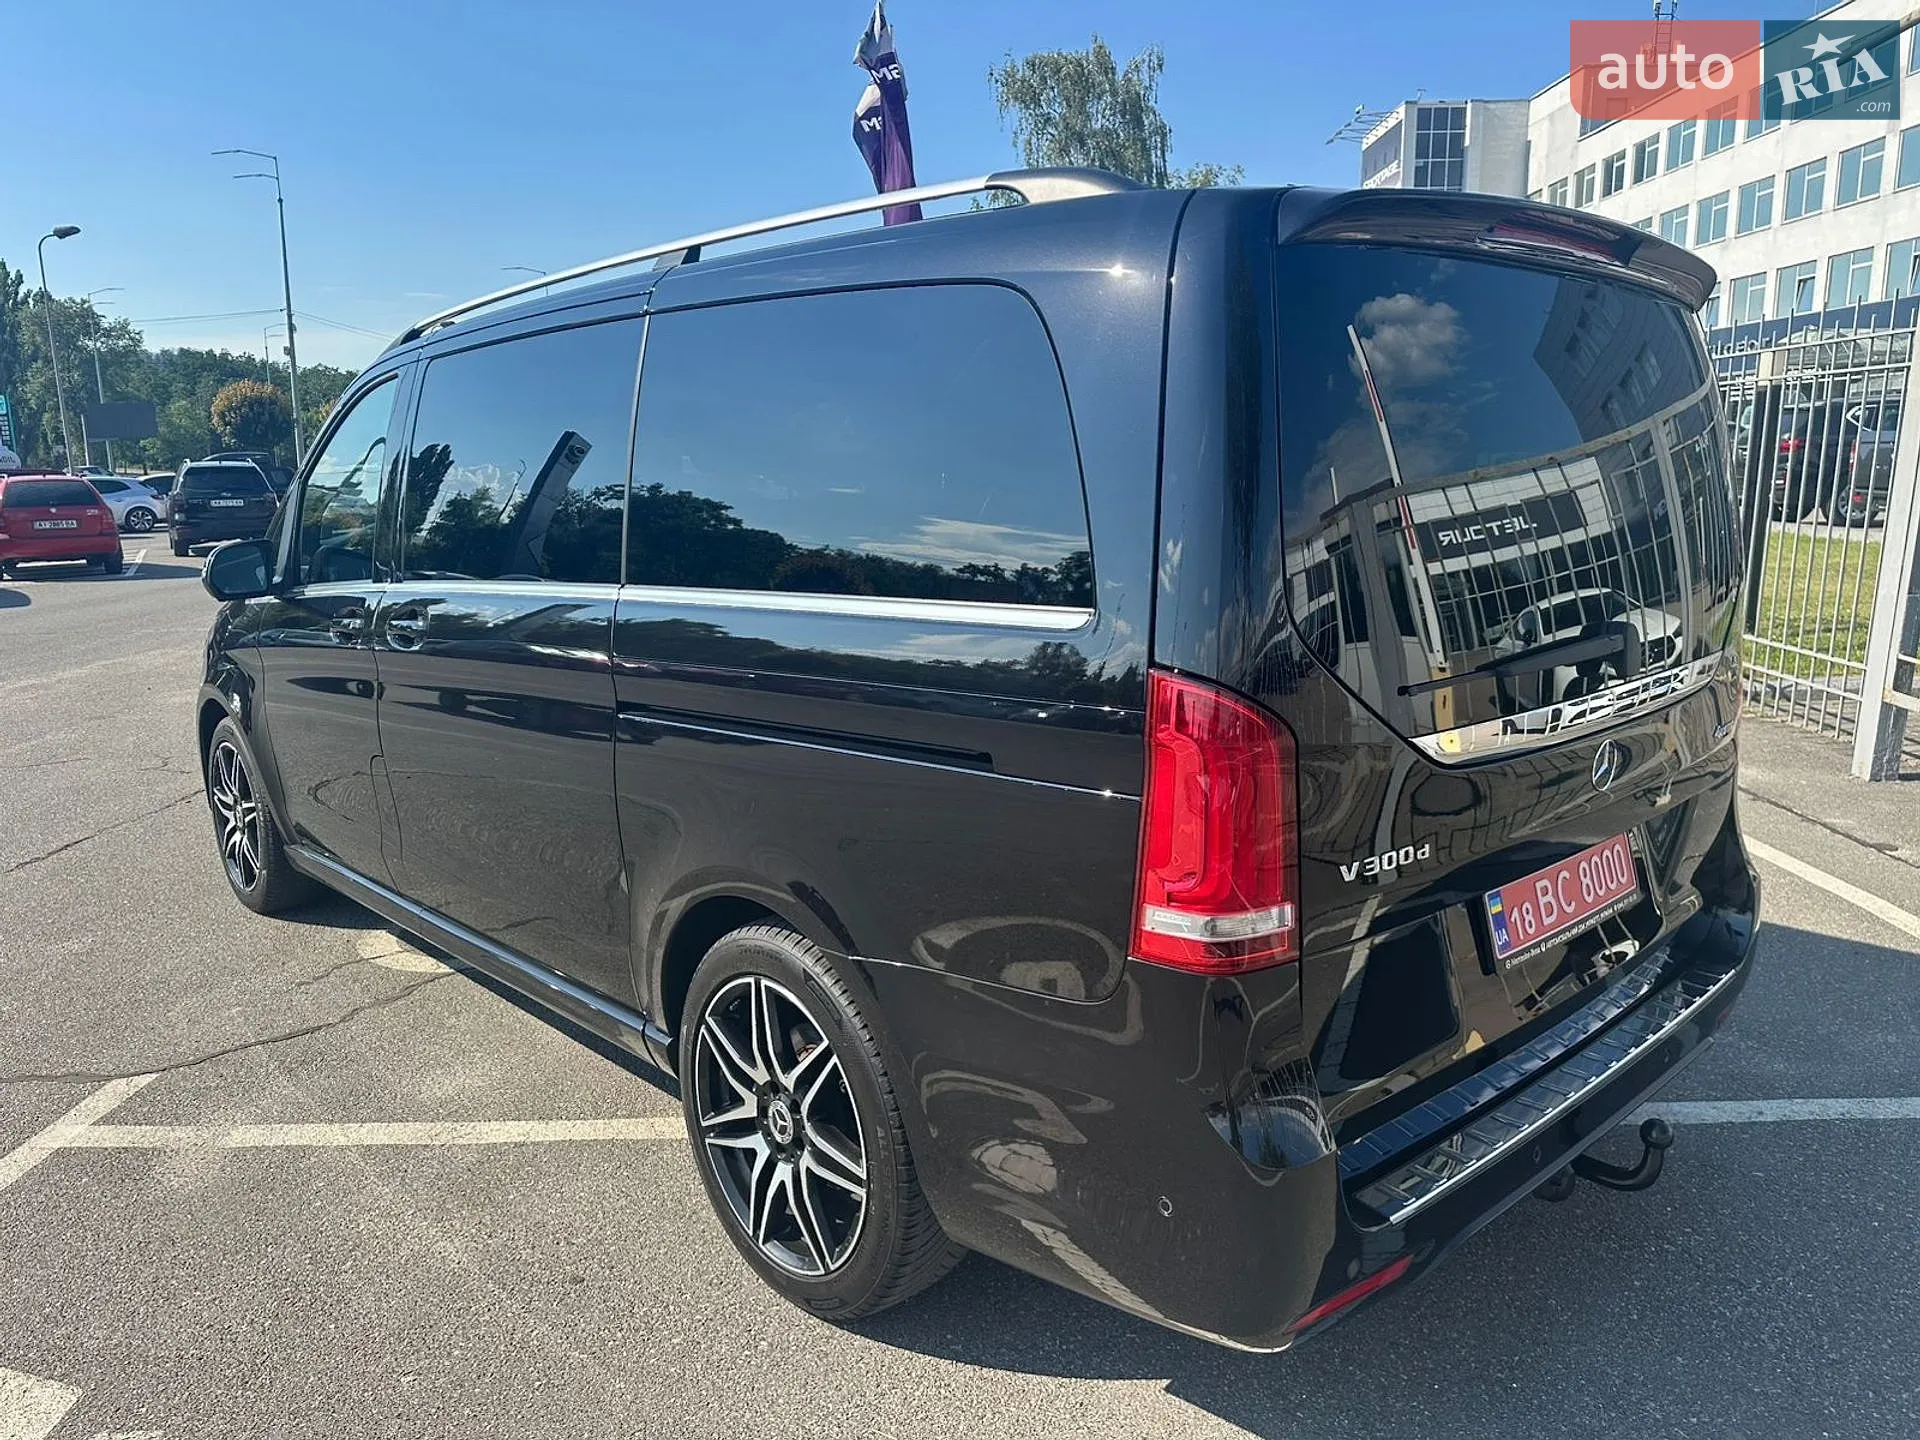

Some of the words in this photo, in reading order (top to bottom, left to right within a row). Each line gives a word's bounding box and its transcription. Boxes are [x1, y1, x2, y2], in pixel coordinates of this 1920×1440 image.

[1340, 861, 1360, 882] V
[1363, 844, 1430, 876] 300d
[1510, 901, 1536, 940] 18
[1535, 870, 1576, 926] BC
[1579, 843, 1628, 903] 8000
[1495, 926, 1510, 945] UA
